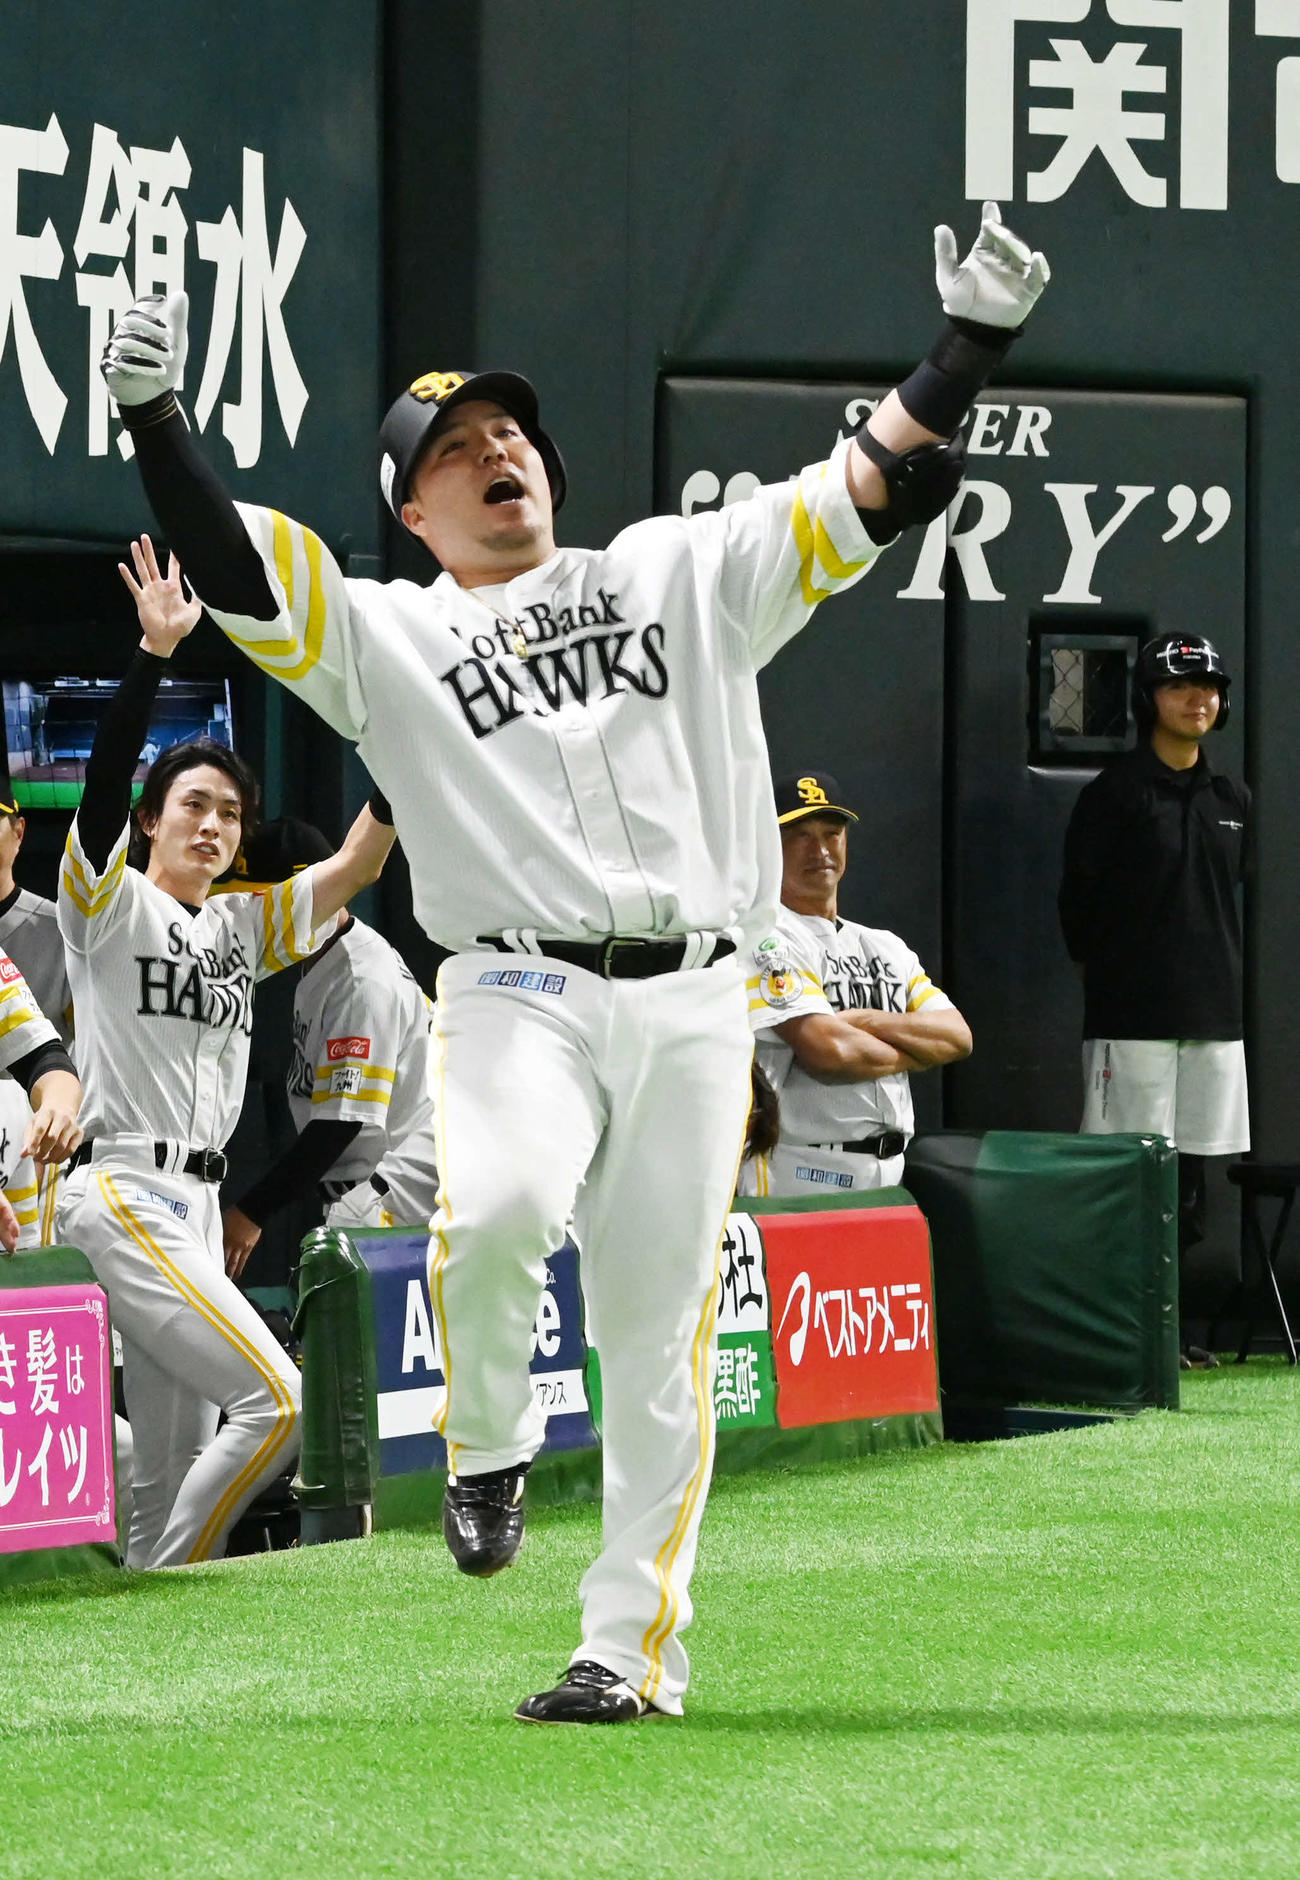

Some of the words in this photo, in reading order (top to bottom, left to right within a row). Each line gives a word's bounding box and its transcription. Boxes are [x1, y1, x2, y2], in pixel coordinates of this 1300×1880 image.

[966, 0, 1300, 210] 関
[450, 588, 625, 659] oftBank
[717, 1225, 763, 1320] 社
[813, 1283, 930, 1358] ベストアメニティ
[715, 1342, 762, 1421] 黒酢
